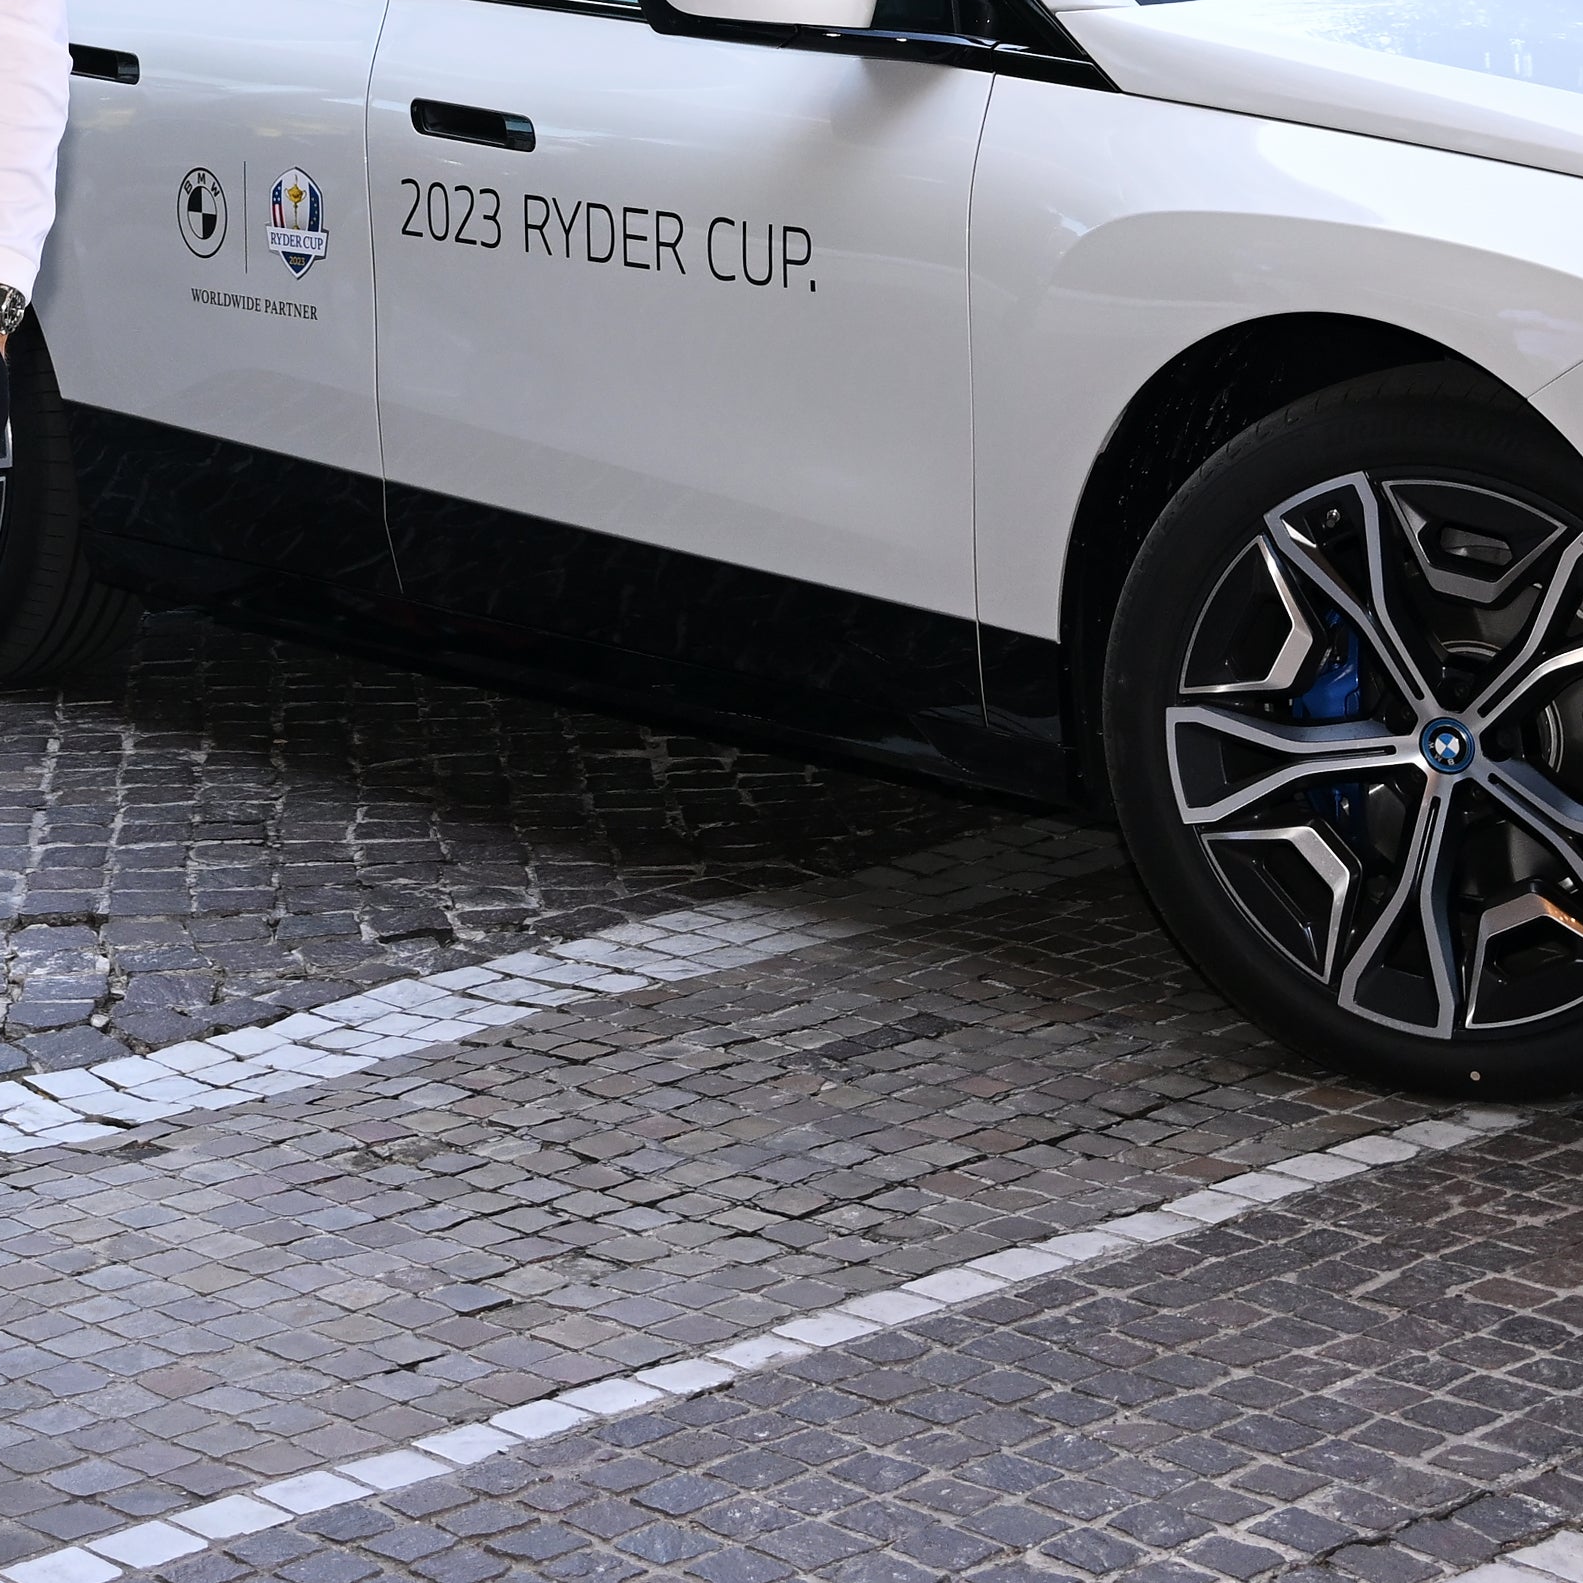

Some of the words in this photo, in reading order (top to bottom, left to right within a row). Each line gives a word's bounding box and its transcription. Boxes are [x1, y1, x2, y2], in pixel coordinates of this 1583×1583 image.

[183, 172, 220, 198] BMW
[270, 231, 303, 249] RYDER
[303, 235, 324, 251] CUP
[400, 177, 502, 249] 2023
[523, 193, 686, 275] RYDER
[707, 216, 816, 293] CUP.
[289, 255, 306, 266] 2023
[190, 287, 261, 313] WORLDWIDE
[264, 298, 319, 321] PARTNER
